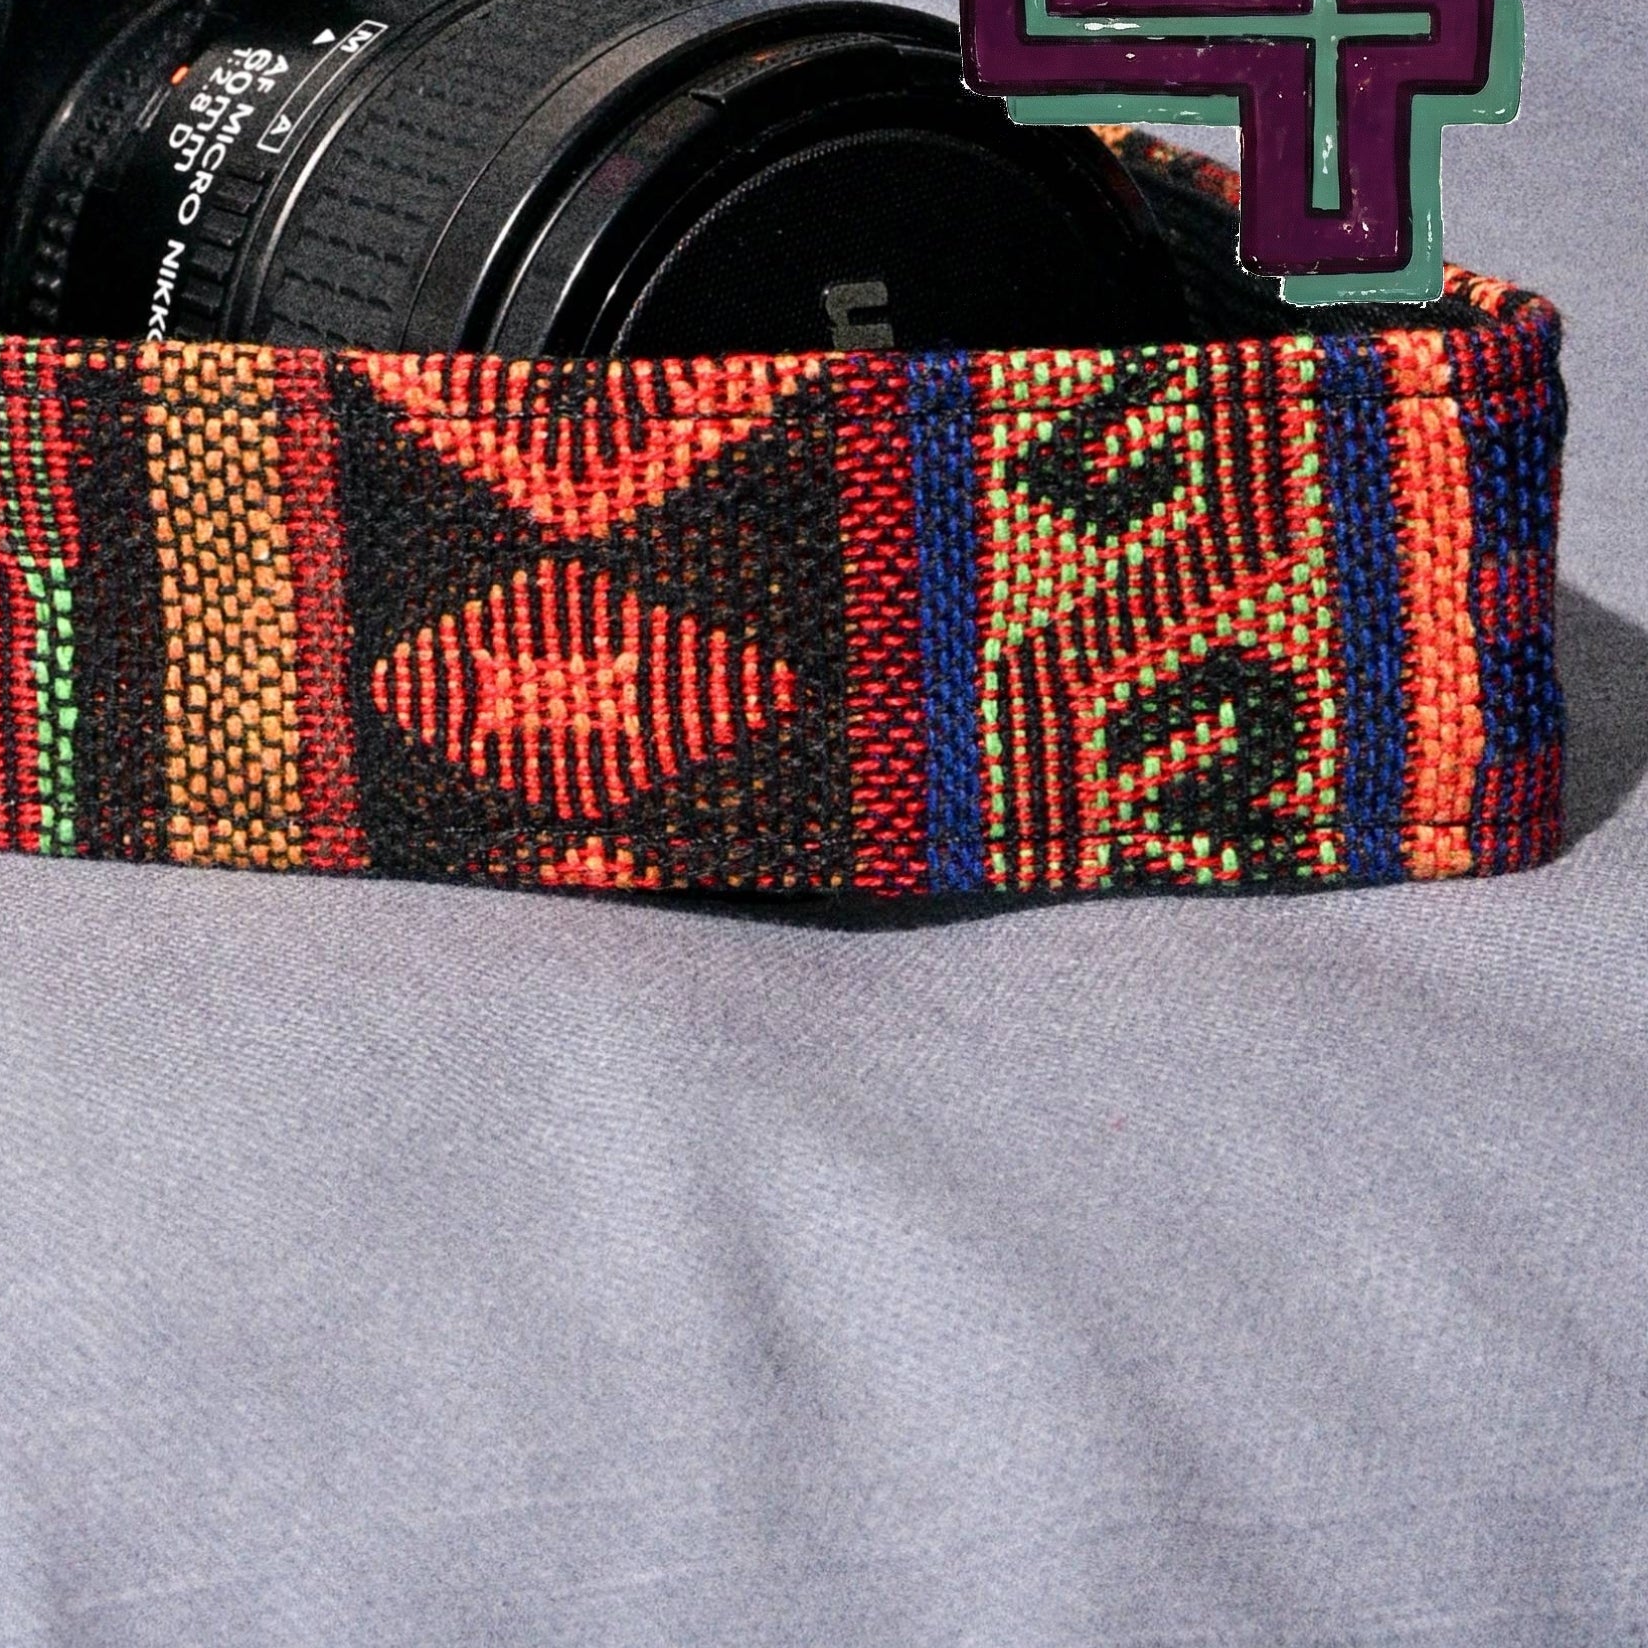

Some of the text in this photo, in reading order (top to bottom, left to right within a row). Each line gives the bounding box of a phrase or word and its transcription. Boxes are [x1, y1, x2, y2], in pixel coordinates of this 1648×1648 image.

[256, 54, 289, 93] AF
[340, 29, 373, 53] M
[169, 47, 252, 149] 1:2.8 D
[174, 49, 273, 172] 60mm
[269, 114, 292, 135] A
[178, 103, 255, 226] MICRO
